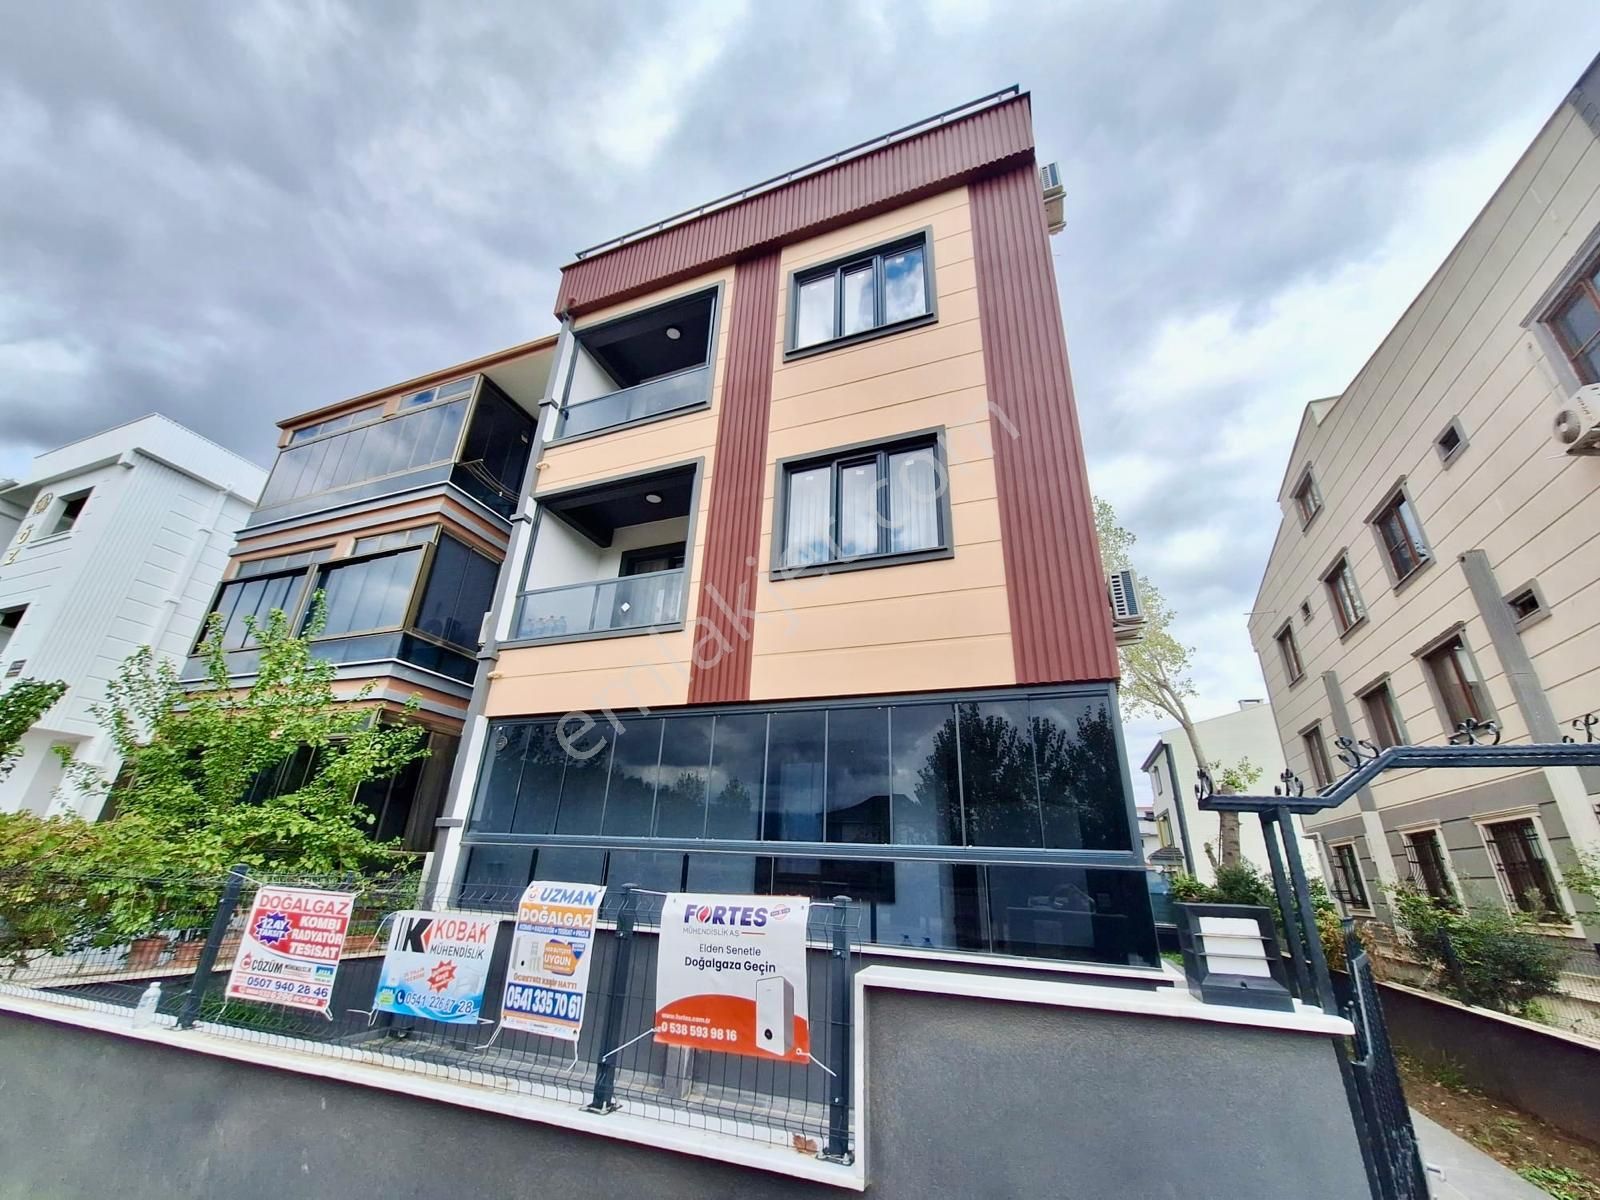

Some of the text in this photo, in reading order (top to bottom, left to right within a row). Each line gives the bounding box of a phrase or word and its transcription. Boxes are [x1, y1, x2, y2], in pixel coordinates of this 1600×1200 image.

[260, 894, 349, 915] DOĞALGAZ
[540, 887, 597, 905] UZMAN
[299, 915, 342, 930] KOMBİ
[520, 905, 593, 928] DOĞALGAZ
[684, 904, 768, 927] FORTES
[291, 928, 343, 945] RADYATÖR
[434, 919, 490, 944] KOBAK
[289, 942, 339, 959] TESİSAT
[430, 943, 484, 960] MÜHENDİSLİK
[699, 943, 761, 956] Elden Senetle
[544, 954, 572, 966] UYGUN
[684, 956, 776, 975] Doğalgaza Geçin
[247, 976, 272, 988] 0507
[274, 980, 295, 992] 940
[297, 984, 311, 995] 28
[313, 987, 329, 998] 46
[405, 992, 426, 1008] 0541
[457, 1000, 474, 1014] 28
[506, 985, 582, 1019] 0541 335 70 61
[661, 1021, 738, 1042] 0 538 593 98 16
